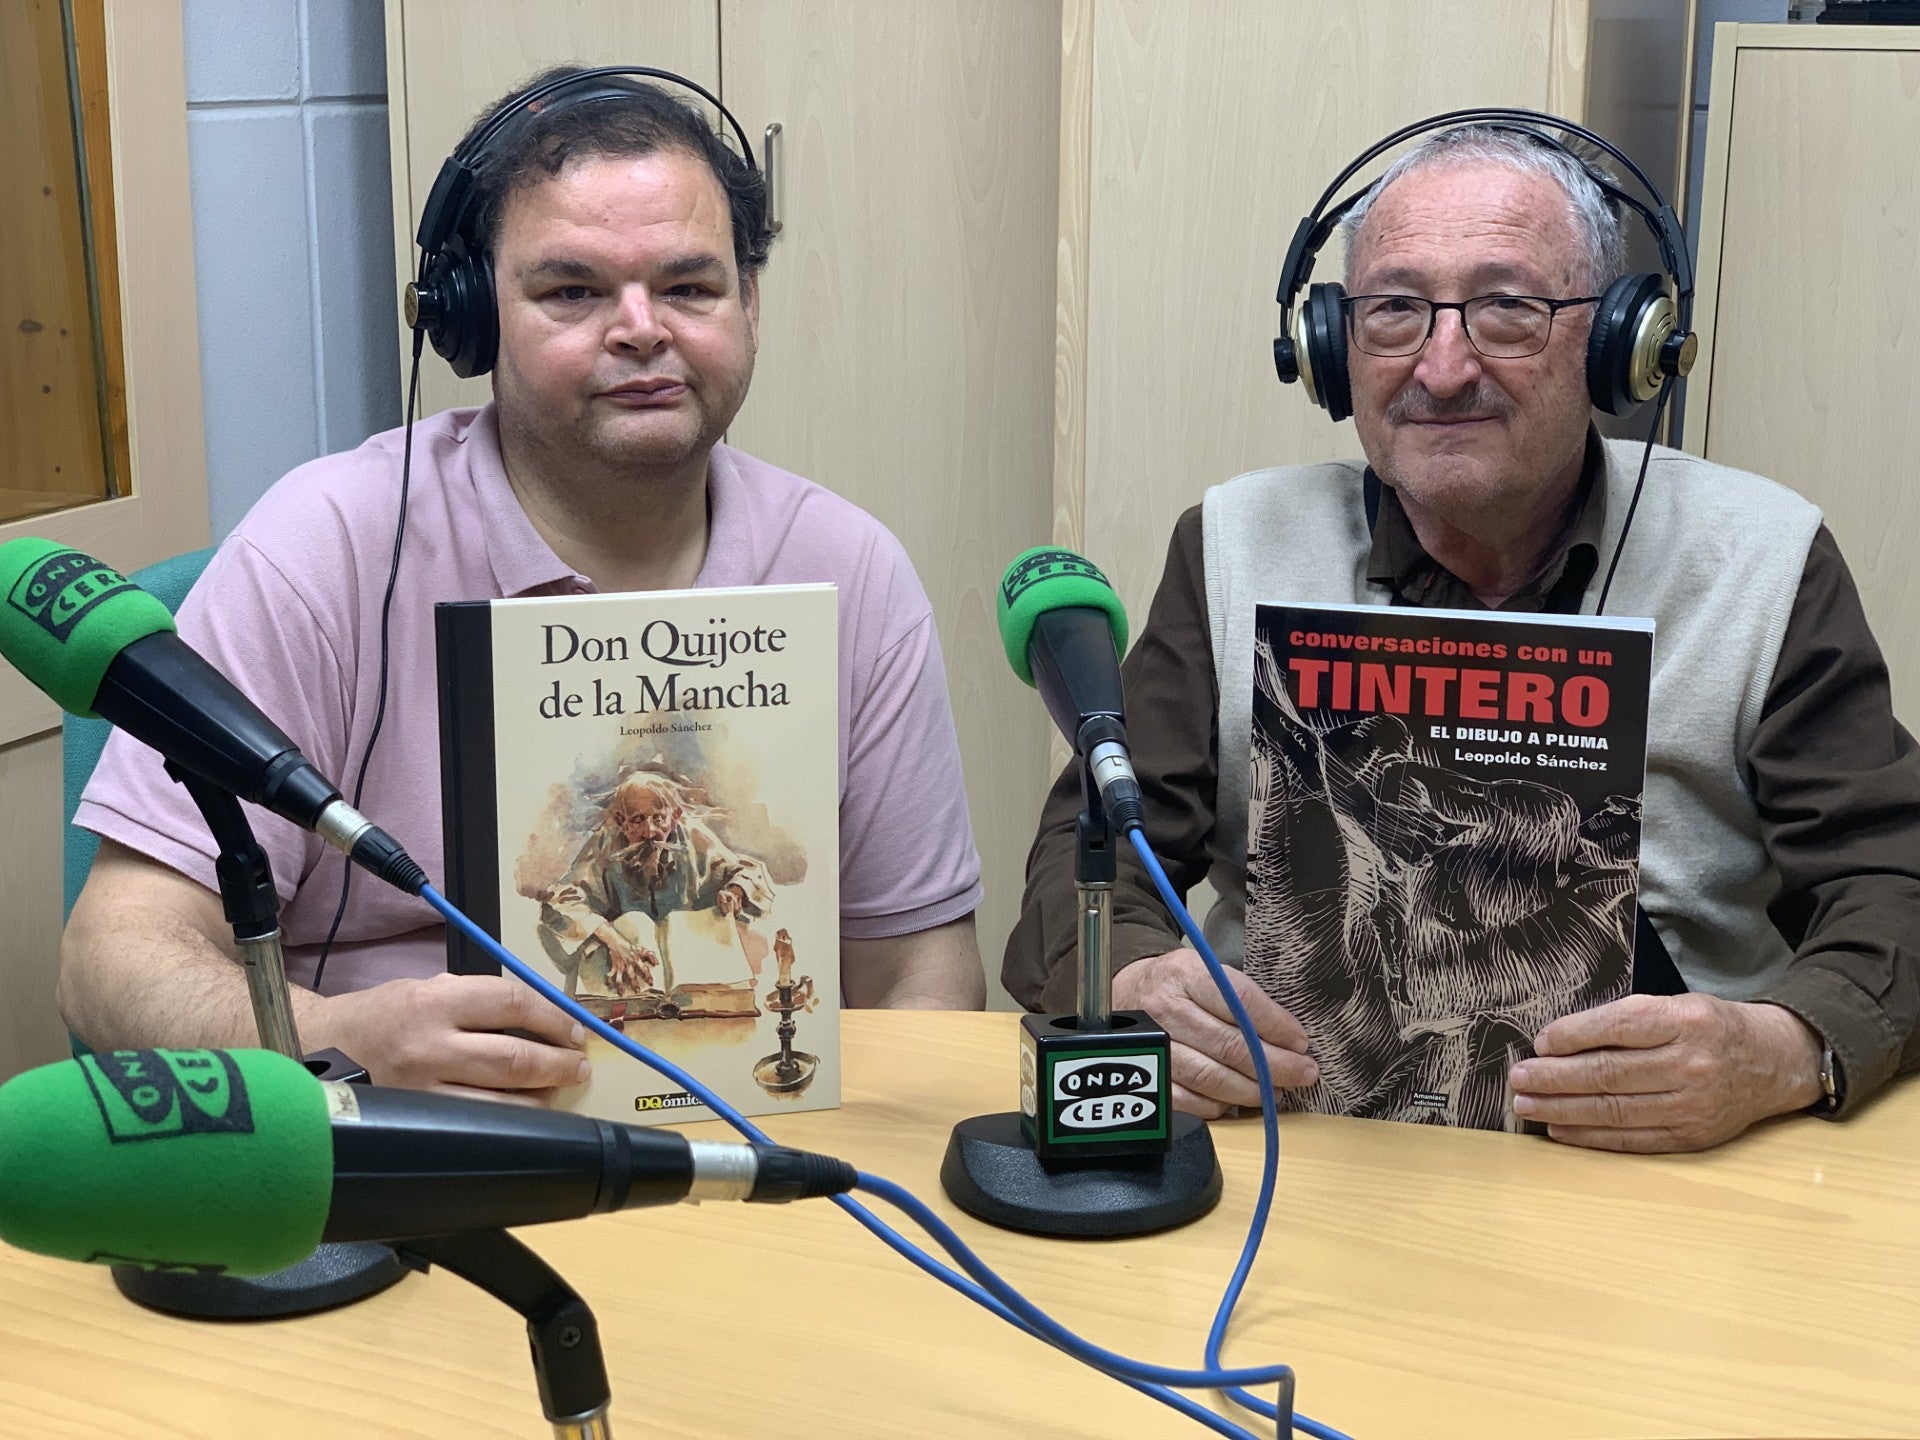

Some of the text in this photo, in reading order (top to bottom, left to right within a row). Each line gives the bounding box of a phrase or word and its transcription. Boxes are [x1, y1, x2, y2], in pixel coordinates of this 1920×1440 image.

[1020, 564, 1097, 585] CERO
[541, 618, 787, 668] Don Quijote
[1289, 631, 1612, 666] conversaciones con un
[540, 670, 791, 719] de la Mancha
[1289, 658, 1611, 728] TINTERO
[620, 721, 712, 737] Leopoldo Sánchez
[1430, 726, 1609, 750] EL DIBUJO A PLUMA
[1455, 748, 1607, 771] Leopoldo Sánchez
[168, 1048, 219, 1094] CE
[1067, 1071, 1144, 1091] ONDA
[637, 1093, 704, 1110] DQómic
[1072, 1102, 1144, 1122] CERO
[1413, 1100, 1446, 1108] ediciones
